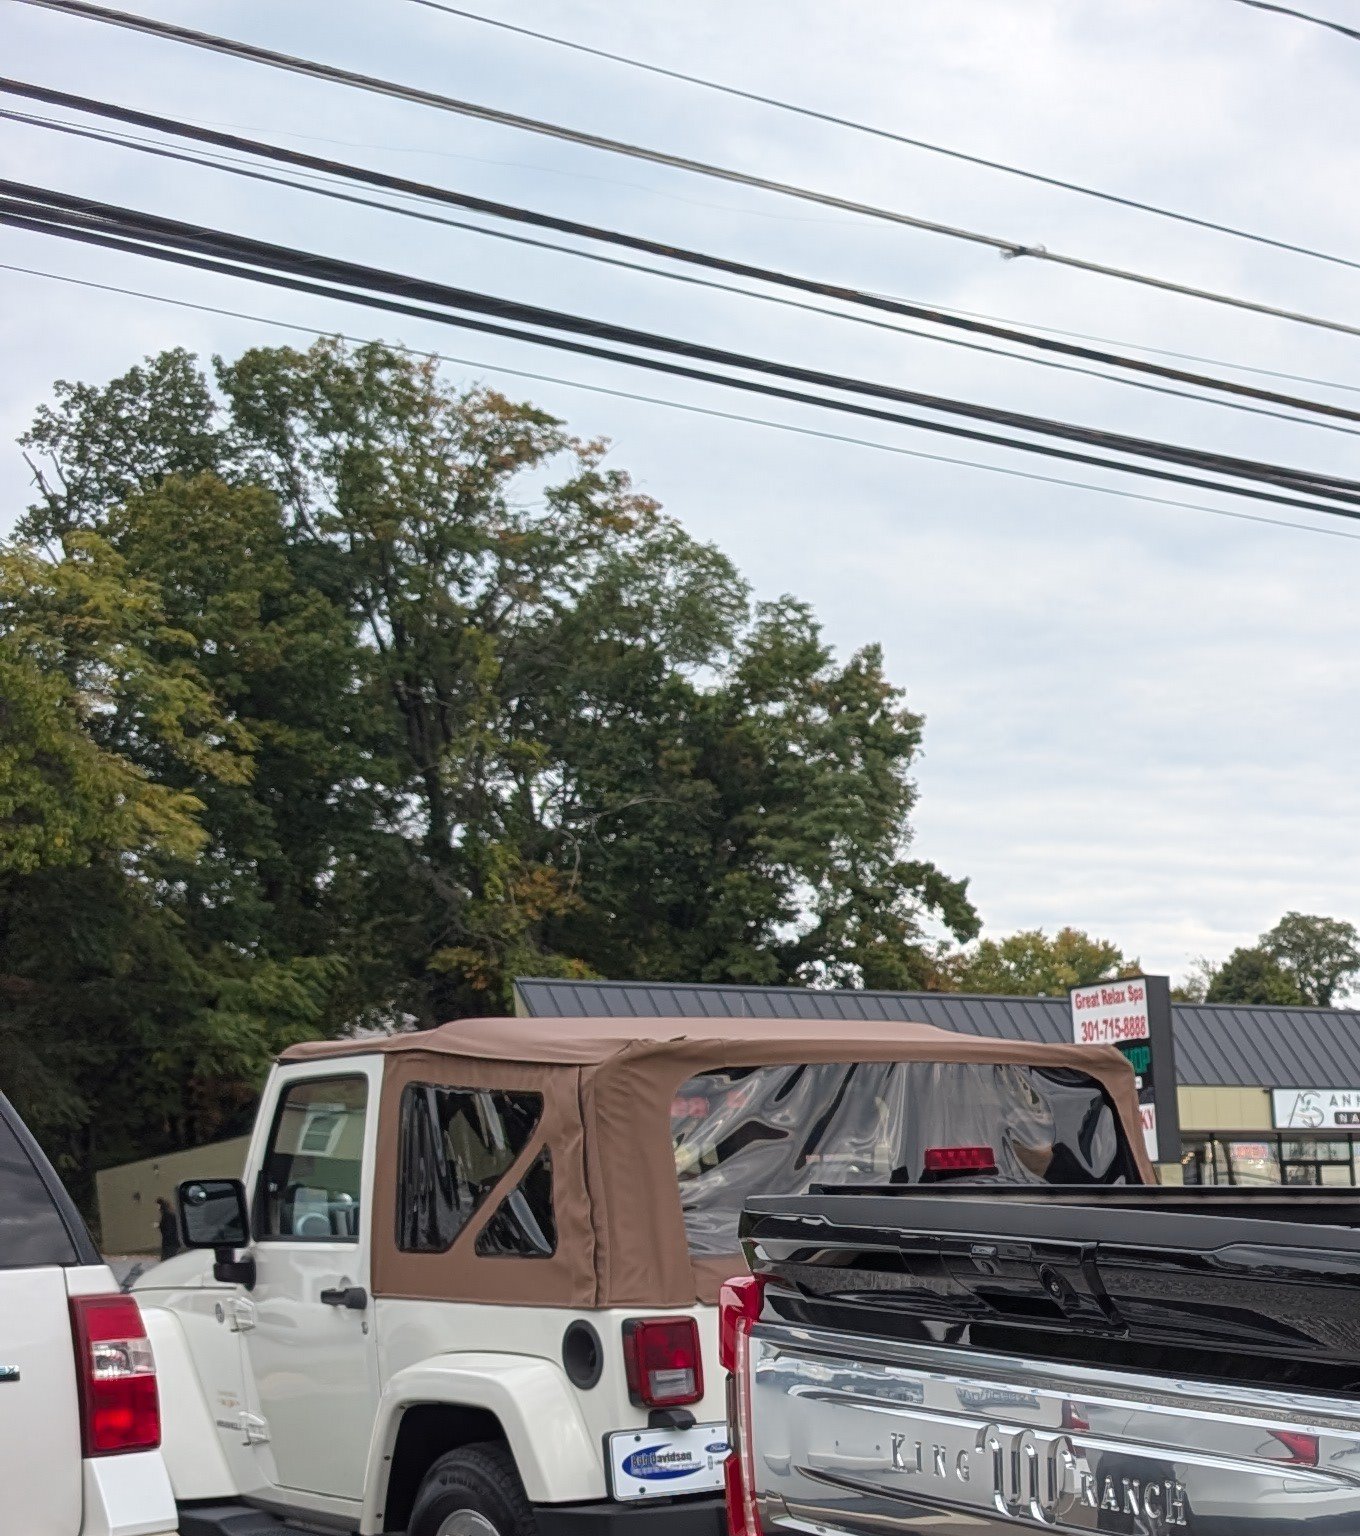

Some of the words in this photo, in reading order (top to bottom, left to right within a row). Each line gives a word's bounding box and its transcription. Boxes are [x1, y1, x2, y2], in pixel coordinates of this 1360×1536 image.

[1075, 991, 1100, 1010] Great
[1101, 987, 1126, 1006] Relax
[1127, 984, 1144, 1006] Spa
[889, 1431, 971, 1483] KING
[1080, 1470, 1188, 1527] RANCH
